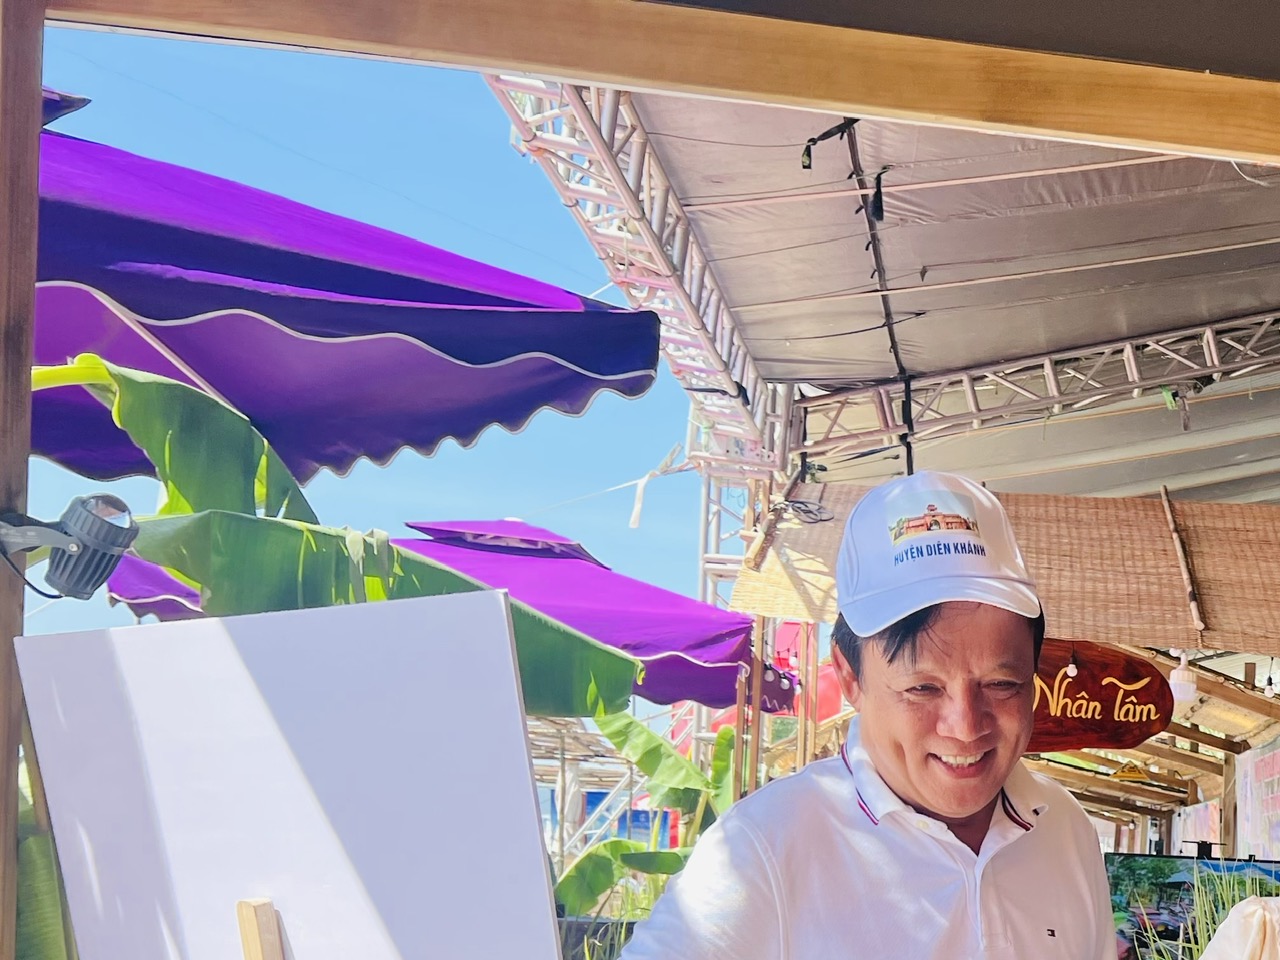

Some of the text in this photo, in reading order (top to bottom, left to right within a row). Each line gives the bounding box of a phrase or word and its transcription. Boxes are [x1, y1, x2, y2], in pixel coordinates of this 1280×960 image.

[894, 540, 986, 566] HUYỆN DIÊN KHÁNH
[1033, 667, 1102, 719] Nhân
